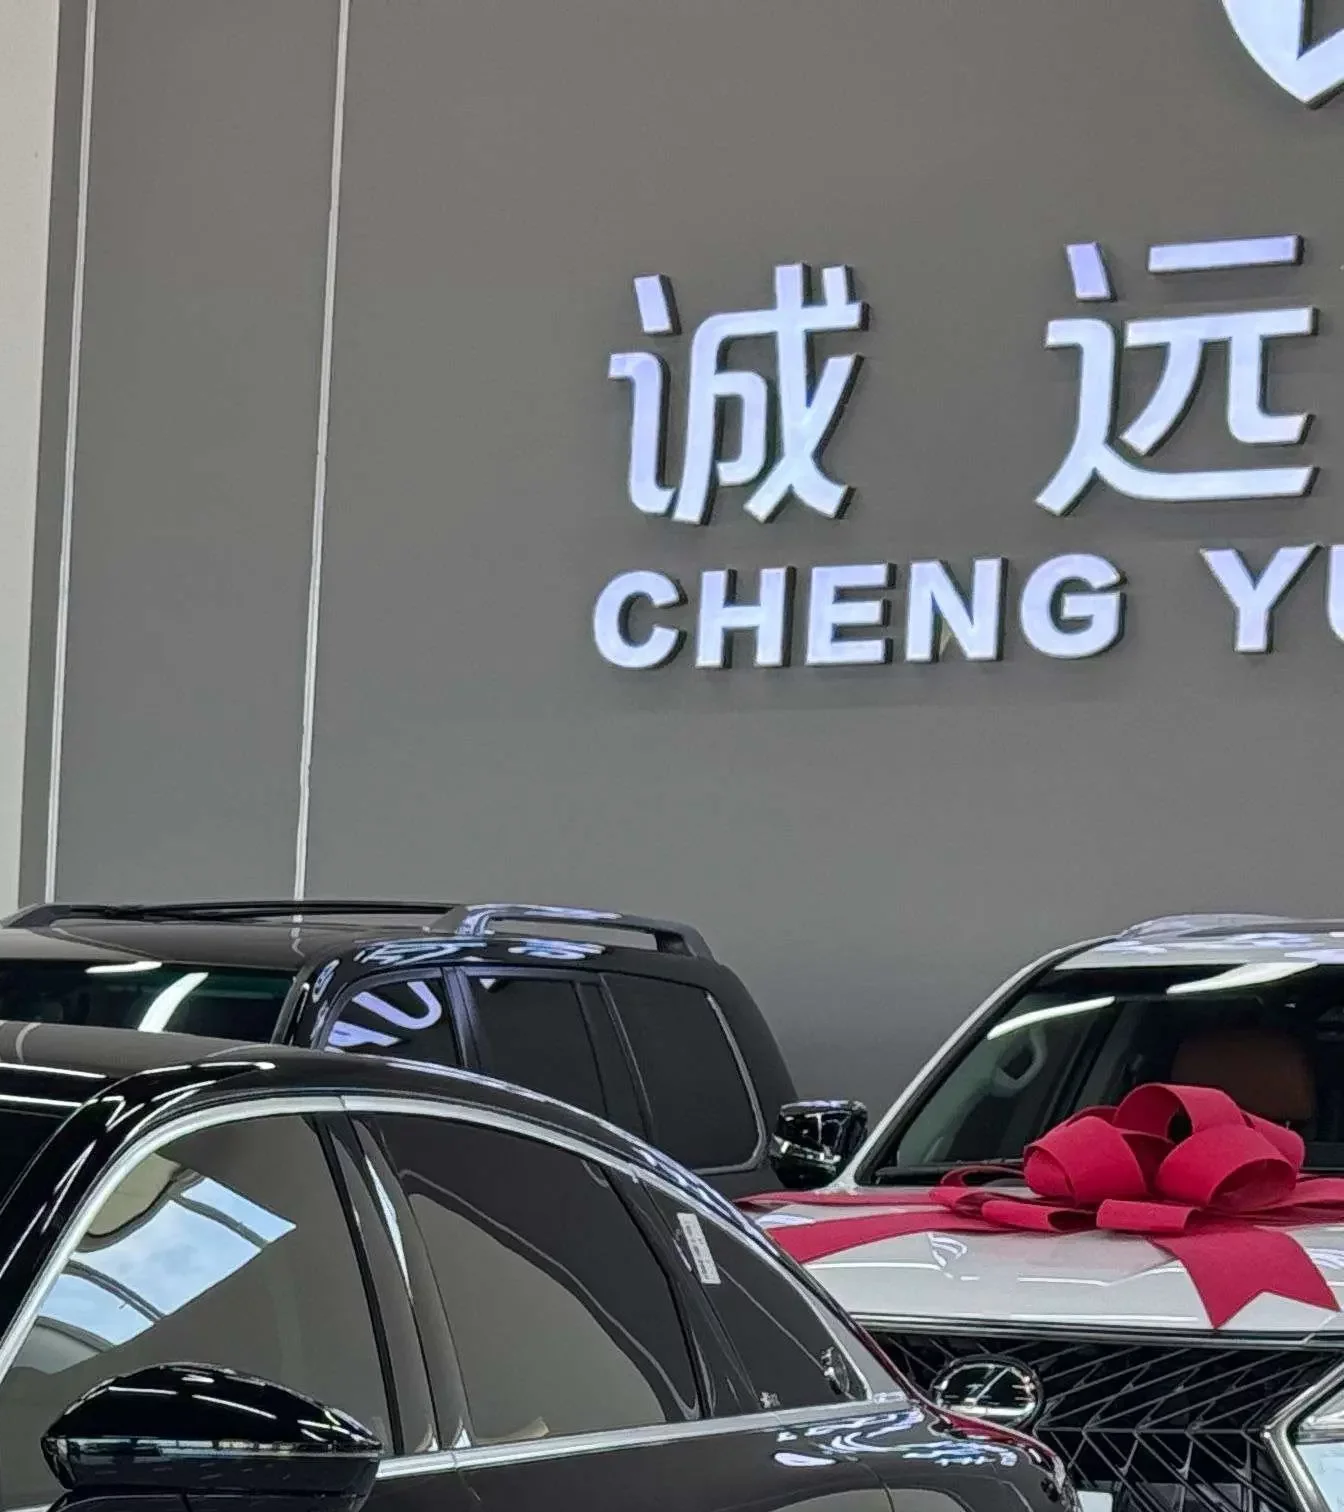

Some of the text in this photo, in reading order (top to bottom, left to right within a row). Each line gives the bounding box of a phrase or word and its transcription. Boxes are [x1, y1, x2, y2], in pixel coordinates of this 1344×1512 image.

[608, 235, 1317, 523] 诚远
[593, 543, 1344, 668] CHENG Y
